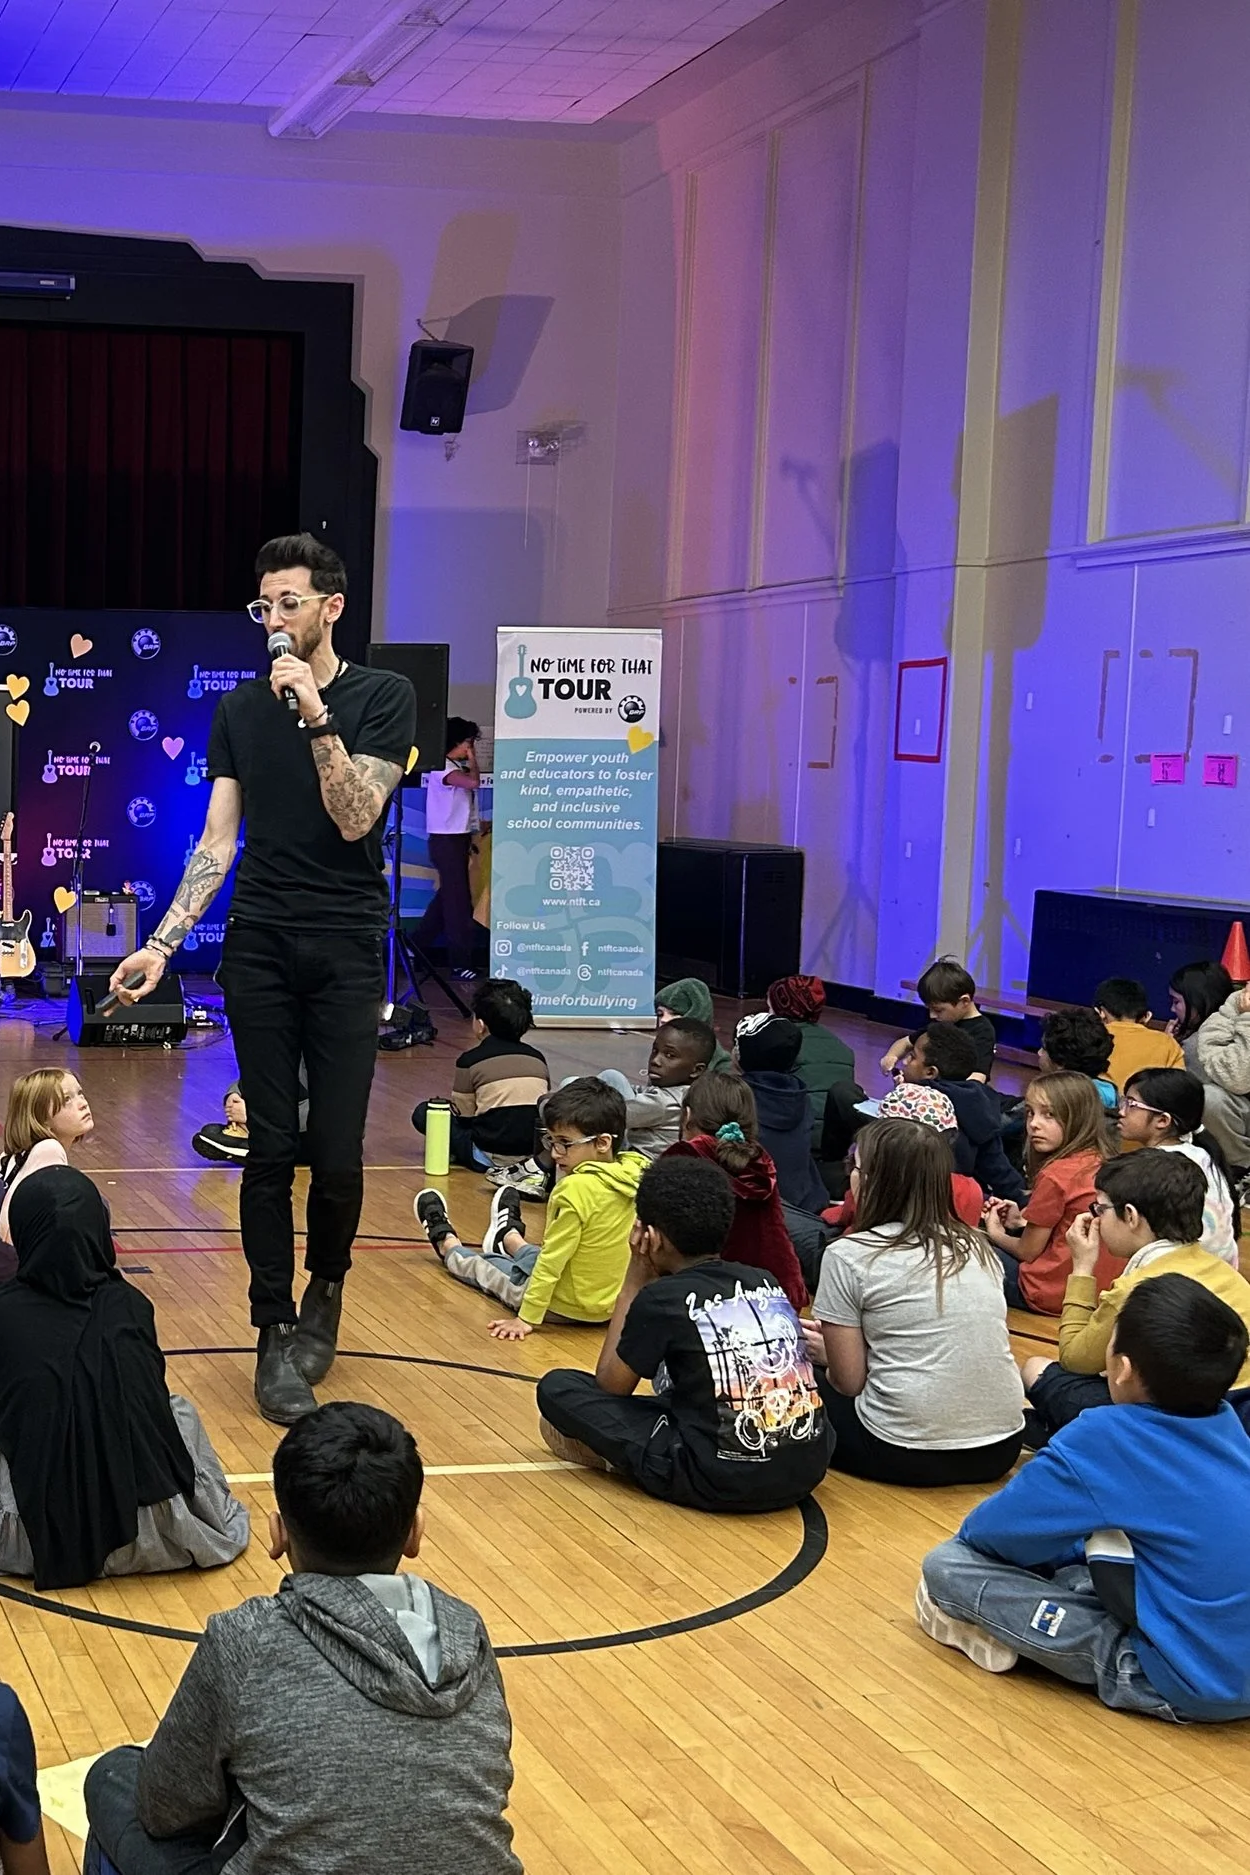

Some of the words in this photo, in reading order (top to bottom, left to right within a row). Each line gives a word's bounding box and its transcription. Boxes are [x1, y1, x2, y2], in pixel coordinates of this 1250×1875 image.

[530, 657, 555, 673] NO
[591, 658, 616, 673] FOR
[621, 658, 653, 675] THAT
[58, 677, 94, 689] TOUR
[538, 678, 612, 700] TOUR
[525, 751, 589, 765] Empower
[591, 751, 629, 766] youth
[500, 768, 526, 779] and
[529, 769, 595, 780] educators
[598, 769, 612, 780] to
[614, 769, 654, 781] foster
[519, 784, 552, 797] kind,
[556, 785, 633, 799] empathetic,
[532, 801, 558, 812] and
[560, 801, 621, 813] inclusive
[506, 818, 553, 829] school
[555, 819, 644, 830] communities.
[542, 897, 601, 907] www.ntft.ca
[496, 921, 530, 930] Follow
[532, 922, 546, 930] Us
[597, 944, 644, 953] ntftcanada
[531, 994, 638, 1010] timeforbullying
